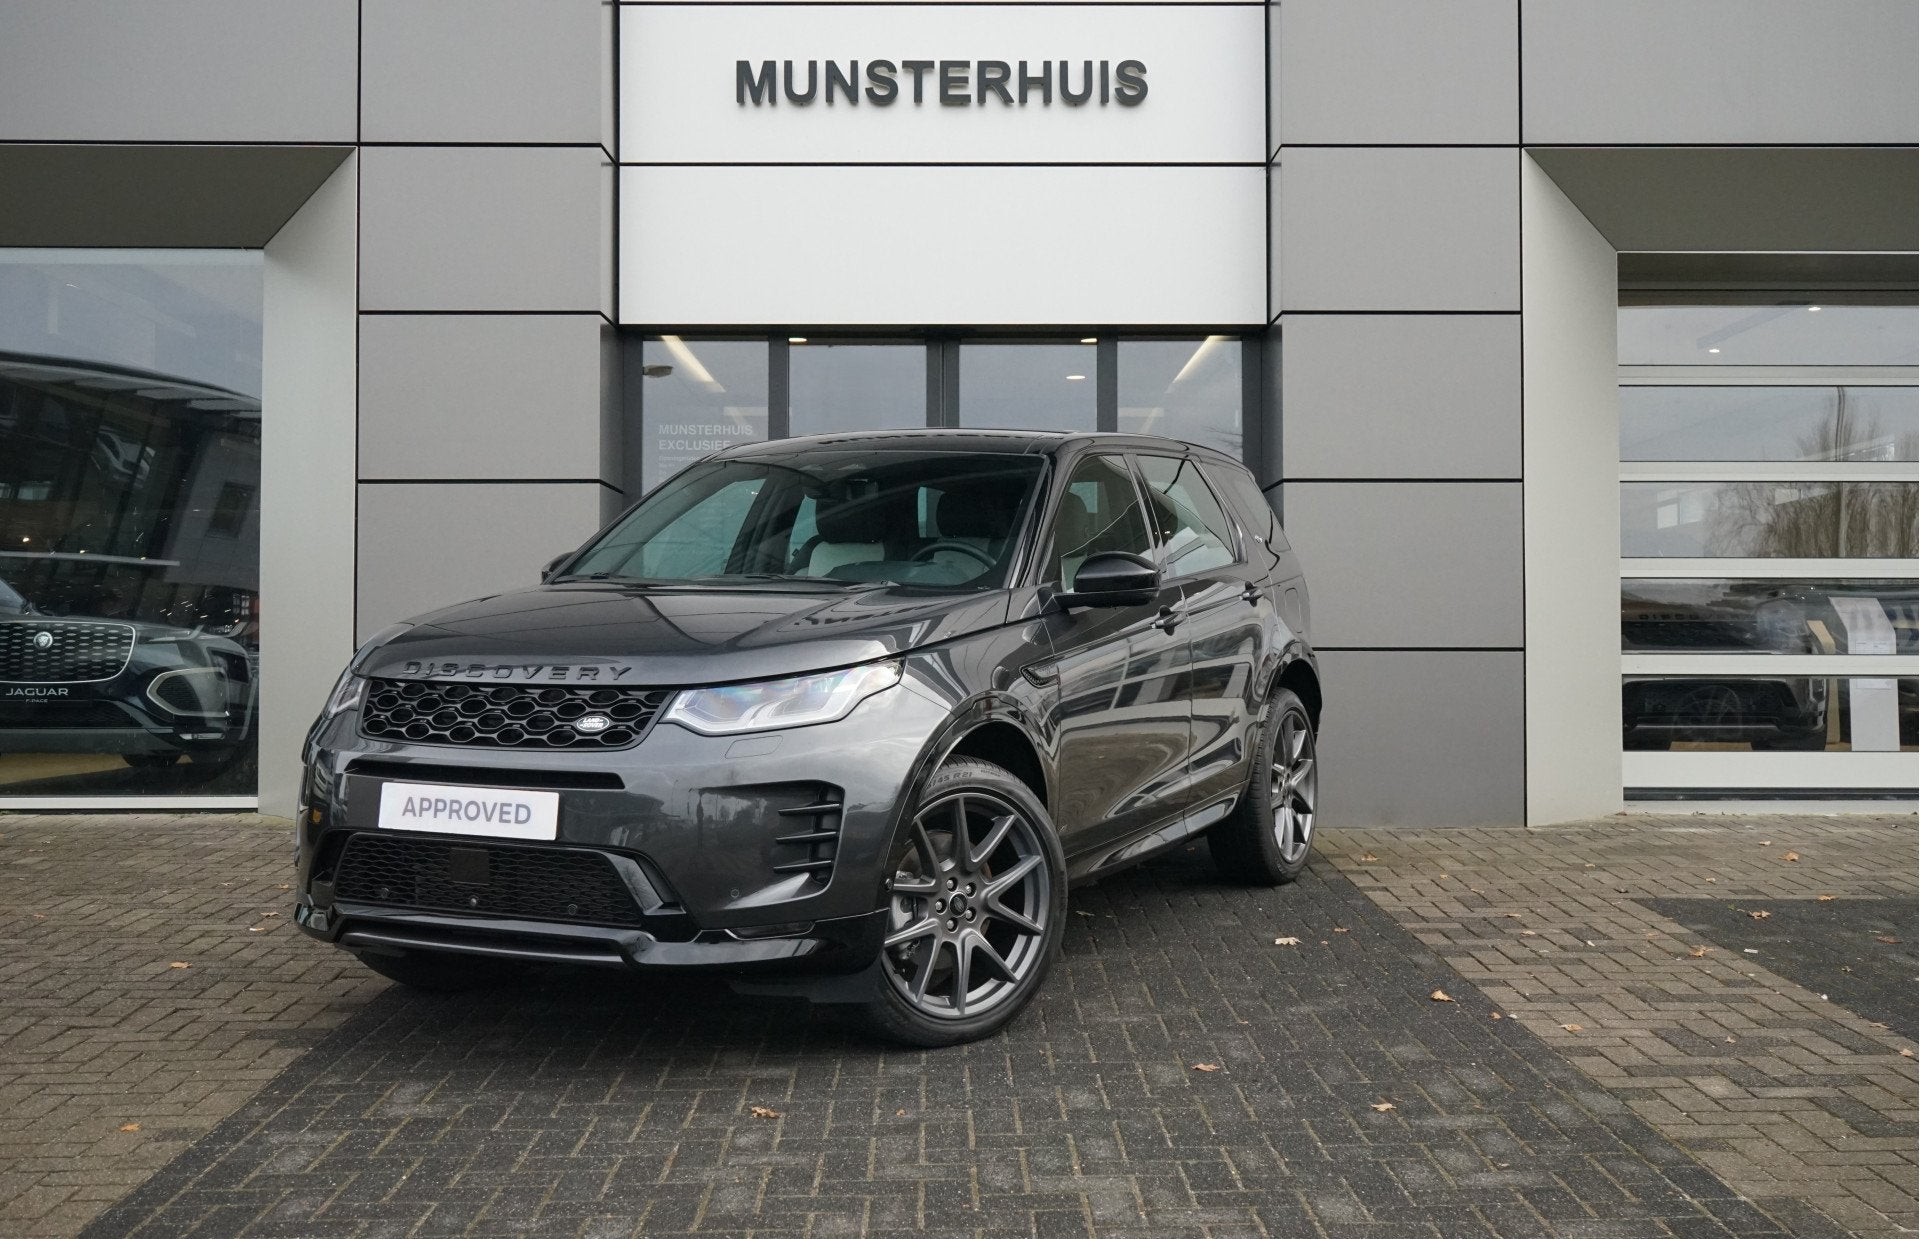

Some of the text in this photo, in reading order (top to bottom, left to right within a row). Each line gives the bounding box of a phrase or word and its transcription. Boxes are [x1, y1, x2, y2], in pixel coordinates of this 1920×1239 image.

[735, 59, 1149, 106] MUNSTERHUIS
[658, 424, 753, 436] MUNSTERHUIS
[658, 440, 731, 450] EXCLUSIEF
[402, 660, 633, 681] DISCOVERY
[5, 687, 69, 696] JAGUAR
[402, 796, 532, 825] APPROVED
